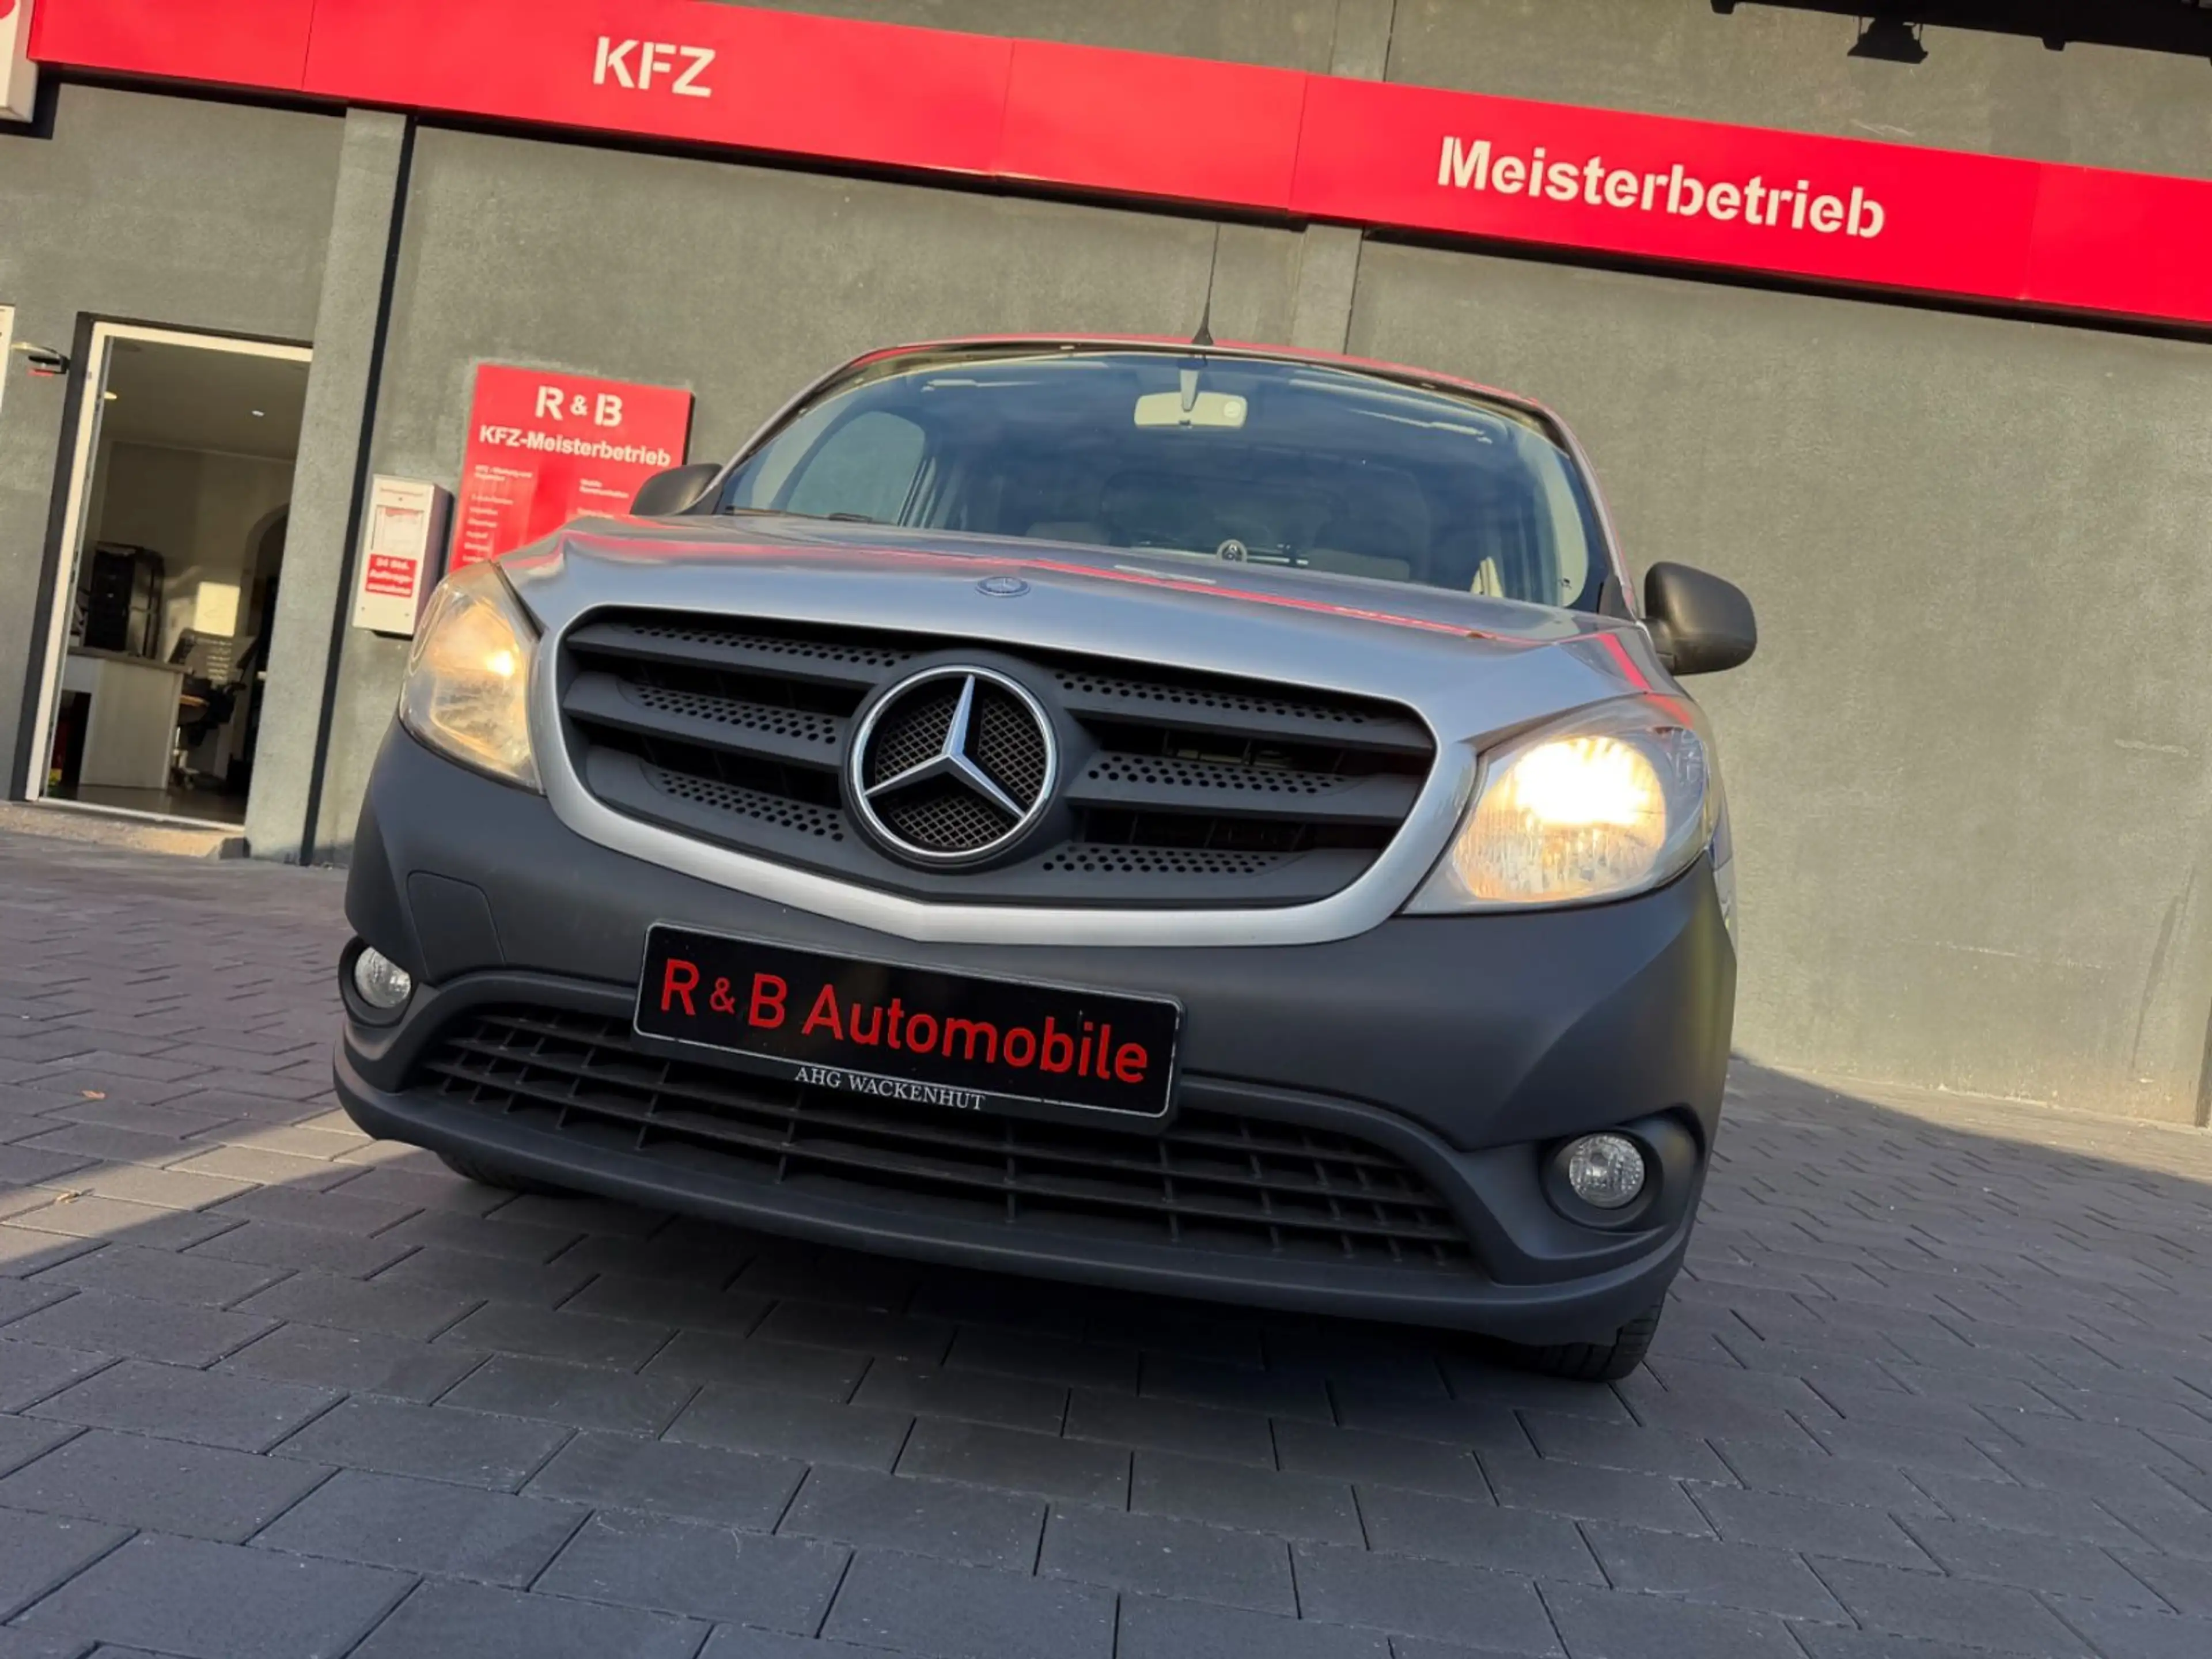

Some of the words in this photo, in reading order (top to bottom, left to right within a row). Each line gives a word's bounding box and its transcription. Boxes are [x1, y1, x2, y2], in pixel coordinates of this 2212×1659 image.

[593, 36, 716, 97] KFZ
[1438, 136, 1884, 238] Meisterbetrieb
[535, 386, 565, 421] R
[570, 395, 588, 415] &
[594, 393, 623, 427] B
[479, 425, 671, 467] KFZ-Meisterbetrieb
[661, 958, 700, 1016] R
[710, 977, 735, 1014] &
[748, 974, 788, 1029] B
[803, 984, 1149, 1084] Automobile
[794, 1066, 842, 1088] AHG
[848, 1074, 987, 1111] WACKENHUT
